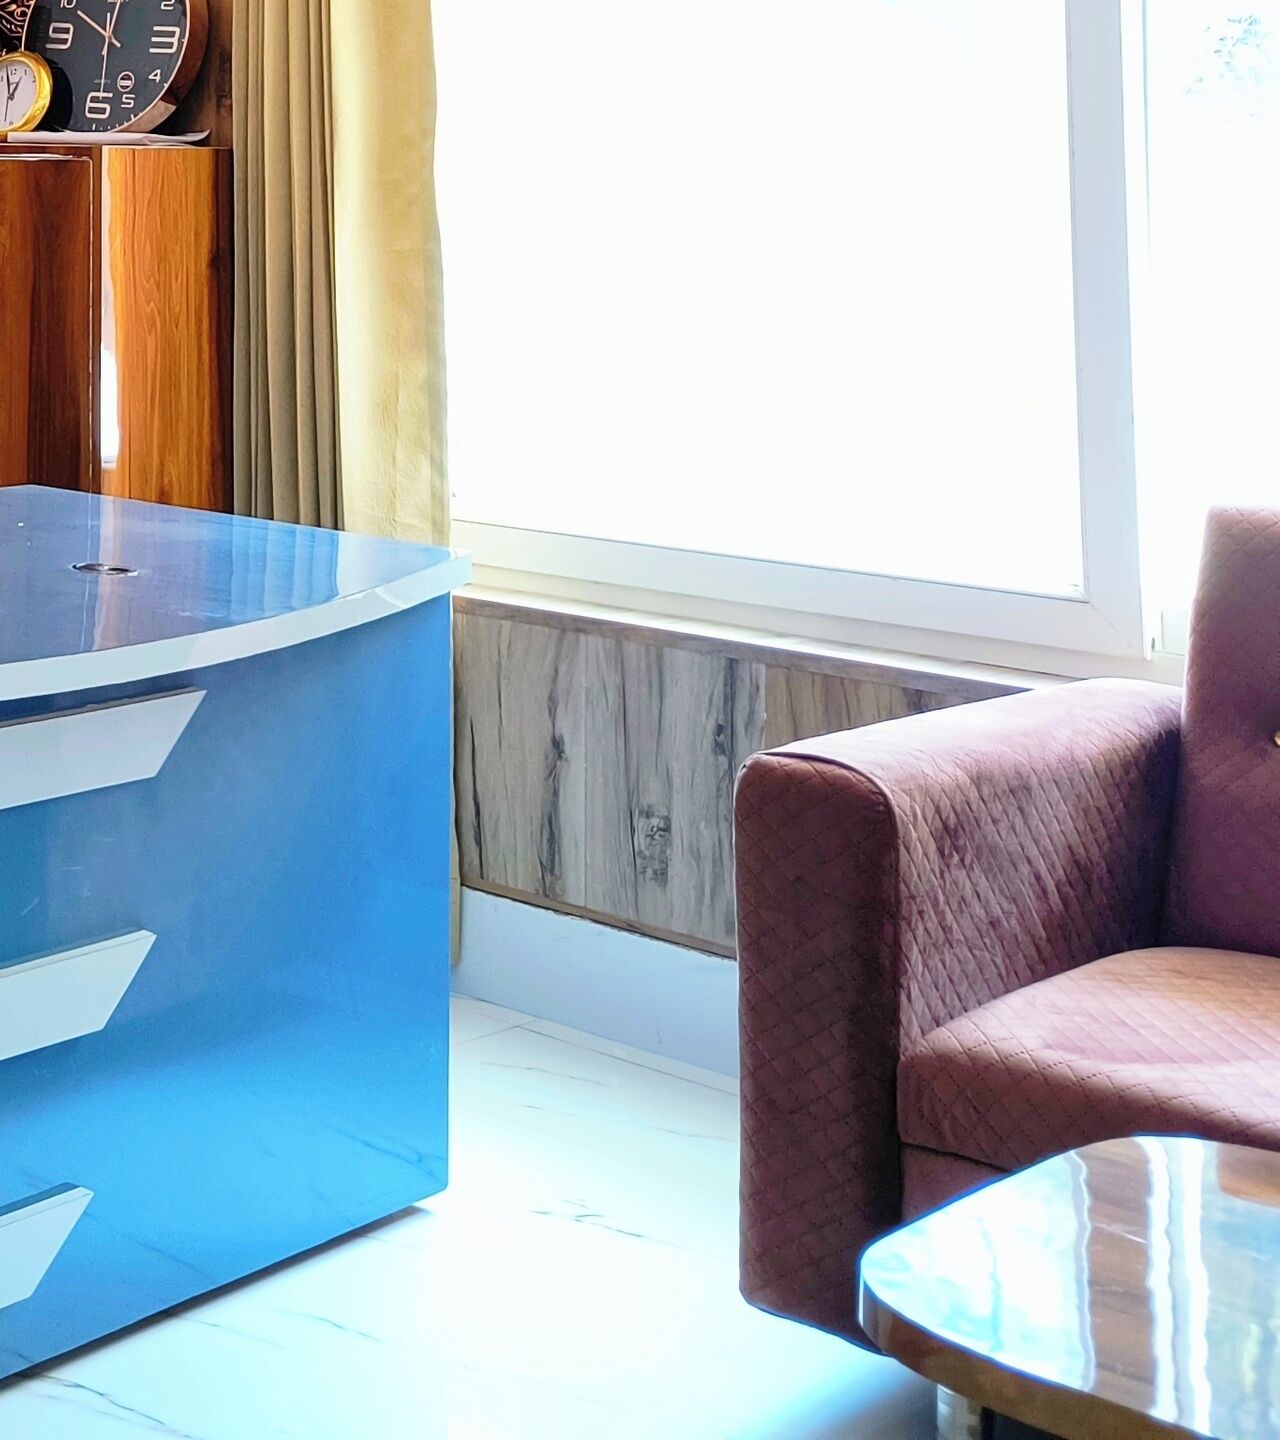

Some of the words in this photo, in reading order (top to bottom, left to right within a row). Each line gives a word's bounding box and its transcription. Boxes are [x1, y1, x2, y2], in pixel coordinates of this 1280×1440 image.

[45, 22, 74, 50] 9
[148, 26, 181, 54] 3
[148, 69, 161, 83] 4
[85, 91, 114, 119] 6
[120, 94, 136, 108] 5
